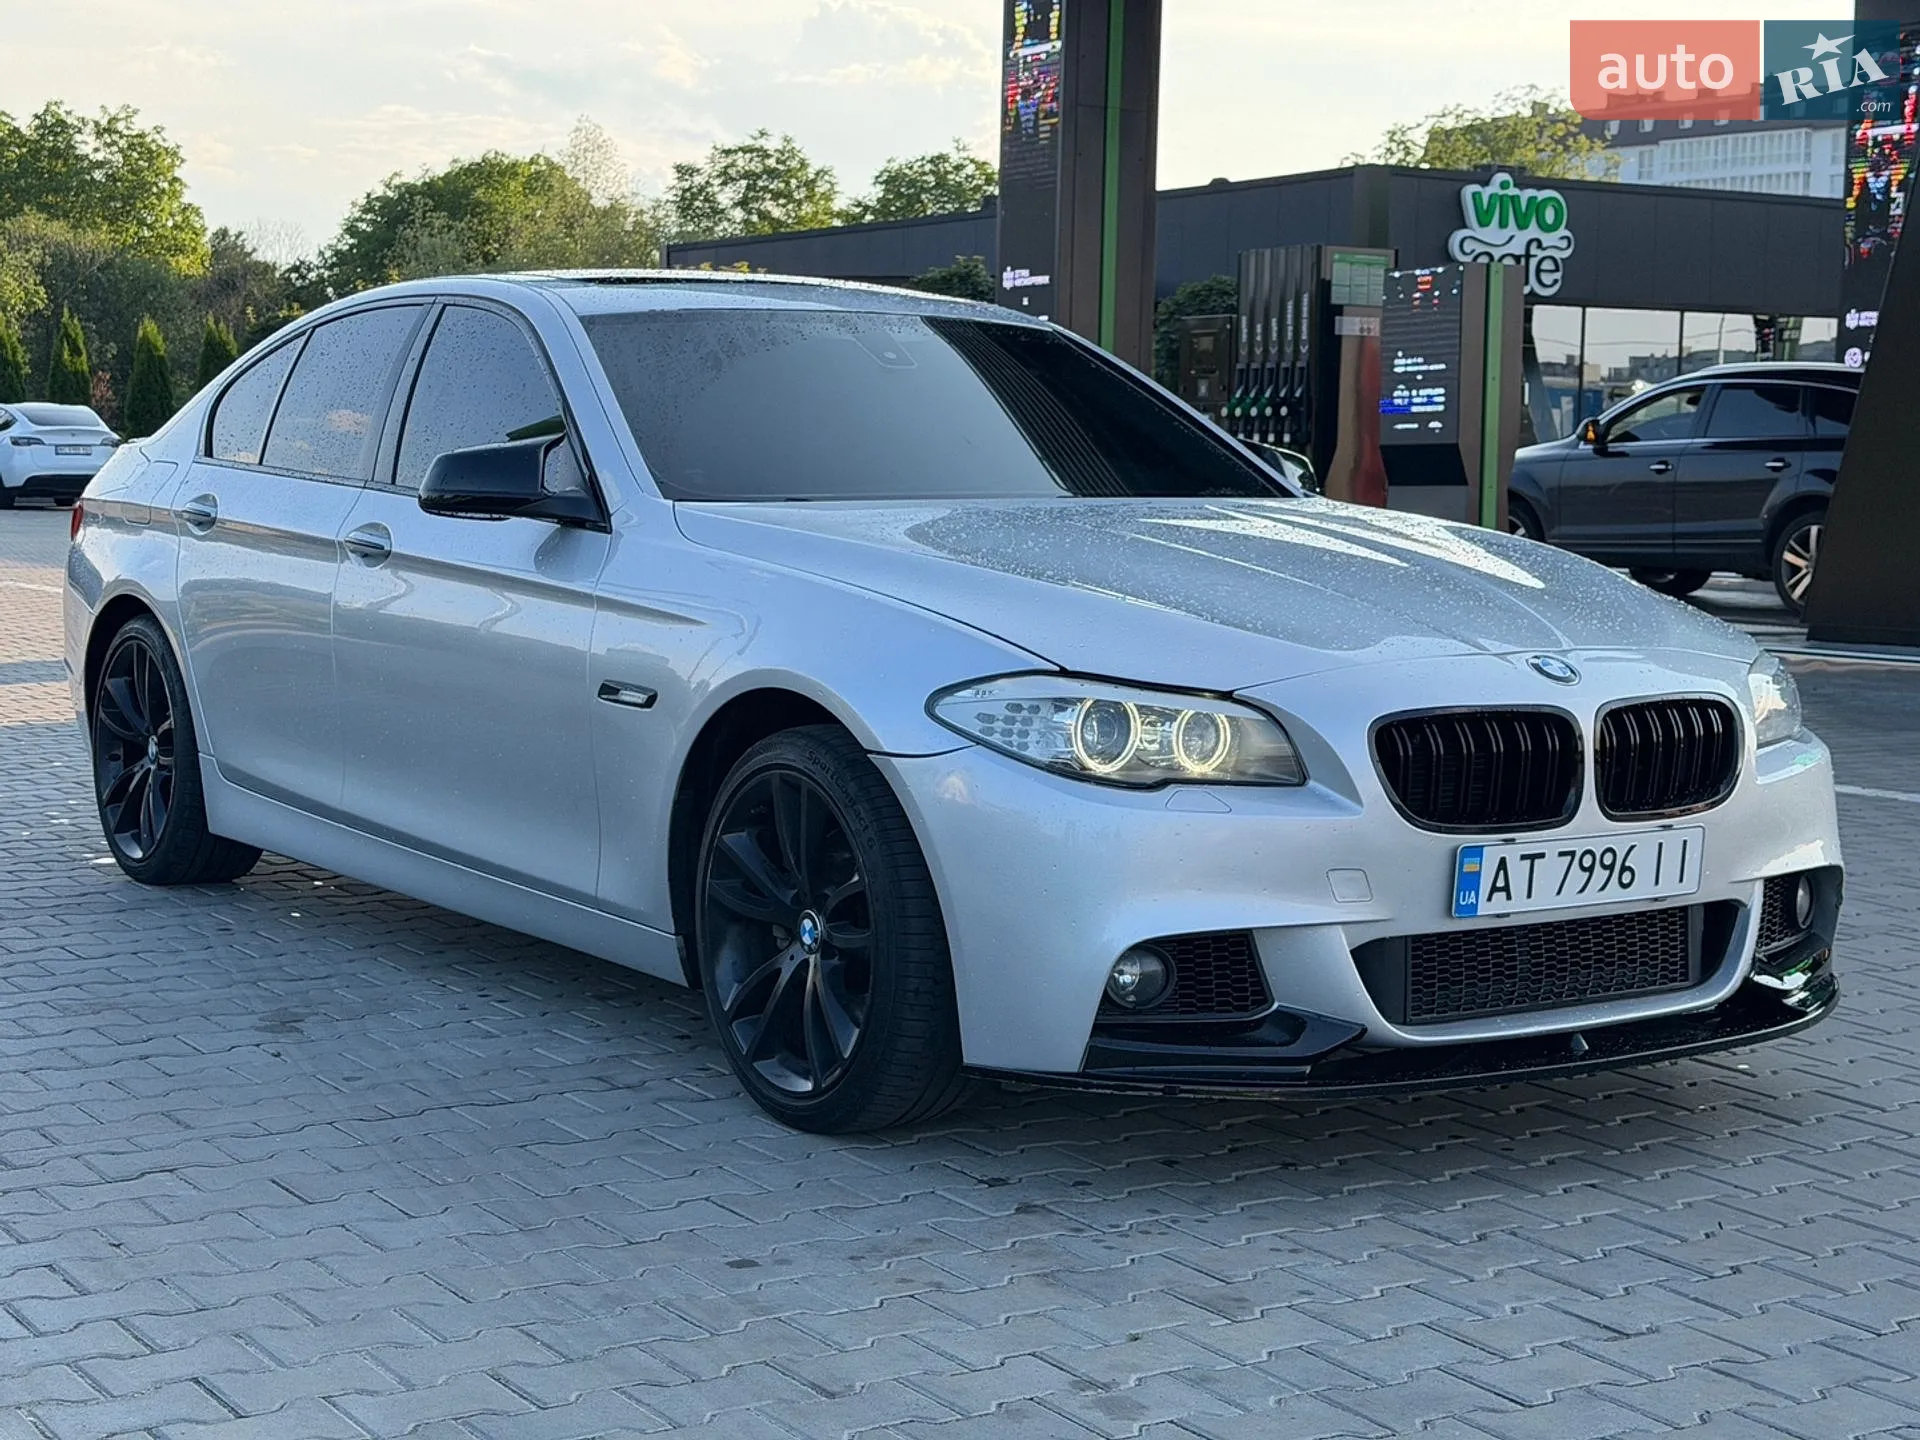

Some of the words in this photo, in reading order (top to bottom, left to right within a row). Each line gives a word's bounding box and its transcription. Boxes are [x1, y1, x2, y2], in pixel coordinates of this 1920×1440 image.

[1471, 179, 1564, 233] vivo
[1468, 237, 1566, 288] fe
[1459, 890, 1477, 906] UA
[1486, 852, 1546, 902] AT
[1555, 843, 1638, 896] 7996
